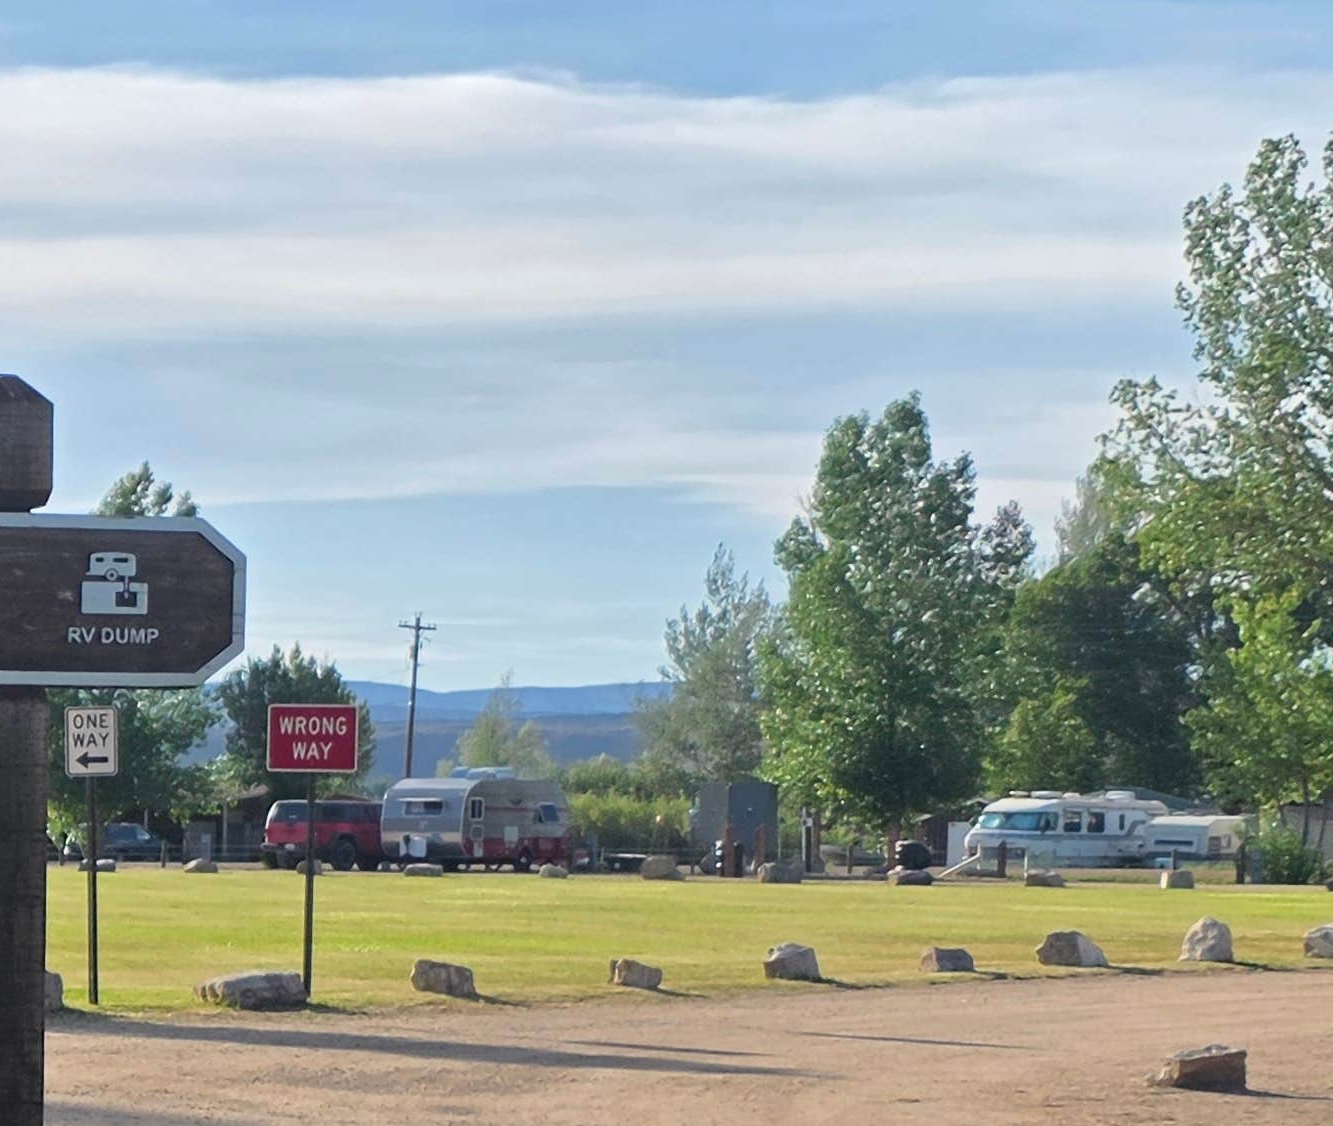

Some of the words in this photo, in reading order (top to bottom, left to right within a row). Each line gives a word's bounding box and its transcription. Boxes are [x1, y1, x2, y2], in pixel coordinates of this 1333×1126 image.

[67, 626, 97, 644] RV
[101, 627, 160, 646] DUMP
[73, 714, 109, 730] ONE
[279, 715, 348, 735] WRONG
[72, 733, 110, 749] WAY
[292, 742, 332, 761] WAY
